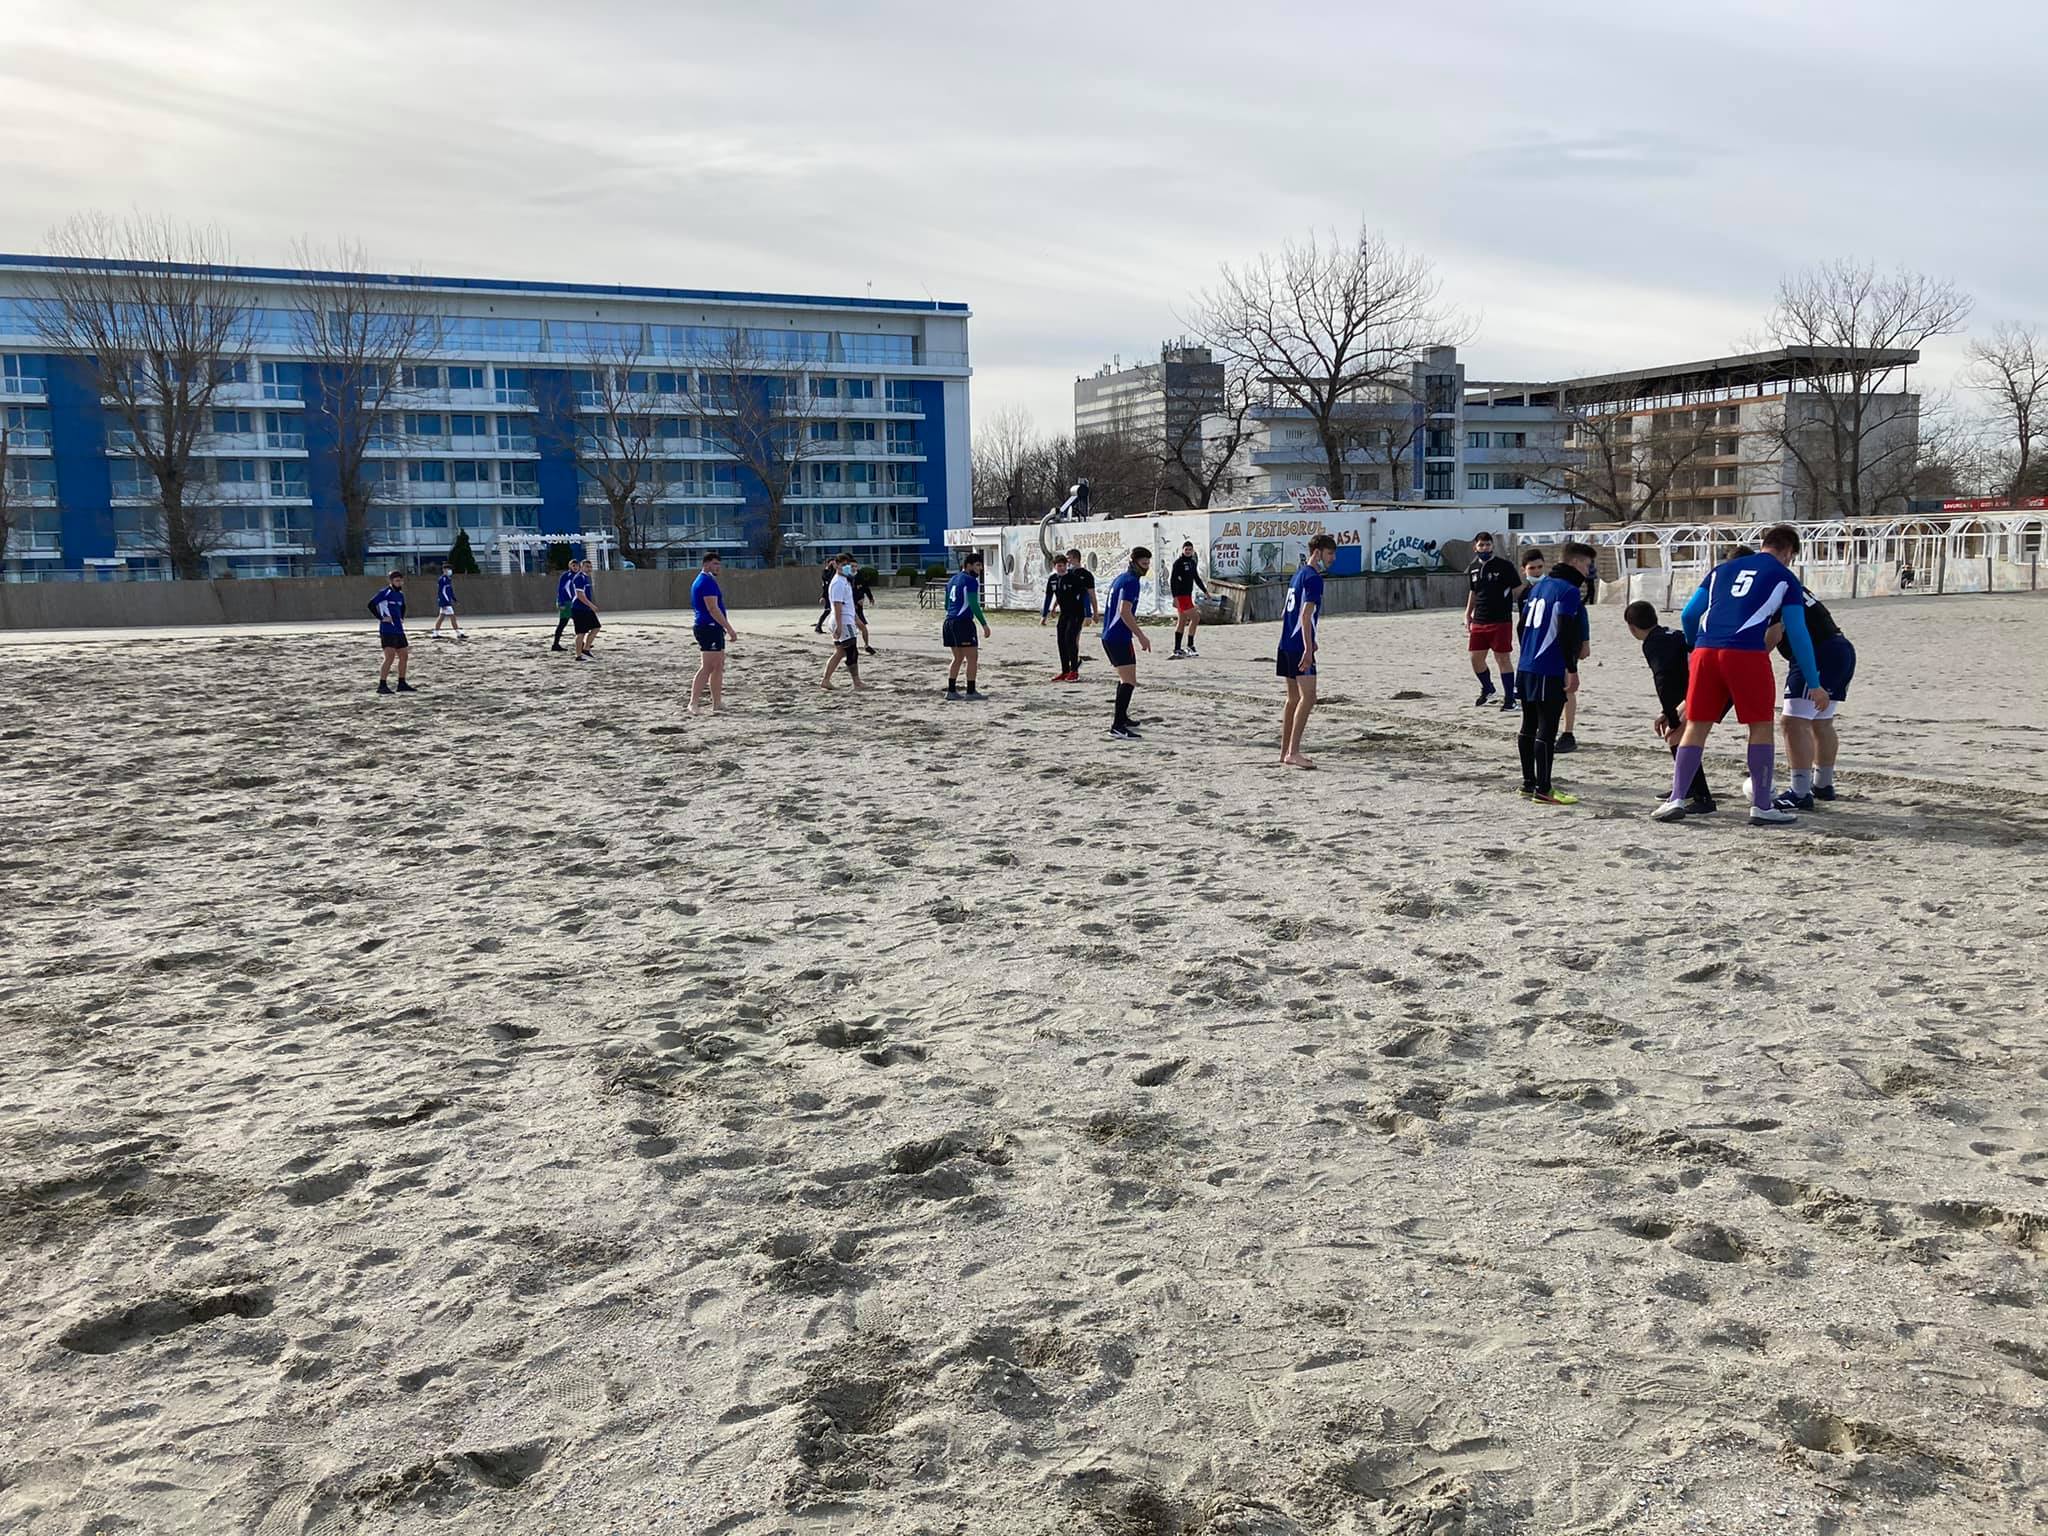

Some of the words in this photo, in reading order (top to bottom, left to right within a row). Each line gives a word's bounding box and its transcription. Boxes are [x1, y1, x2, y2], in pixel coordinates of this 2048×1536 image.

[1222, 522, 1241, 537] LA
[1246, 520, 1326, 537] PESTISORUL
[1217, 551, 1239, 559] ZILEI
[1730, 569, 1758, 598] 5
[949, 585, 957, 602] 4
[1525, 597, 1546, 629] 10
